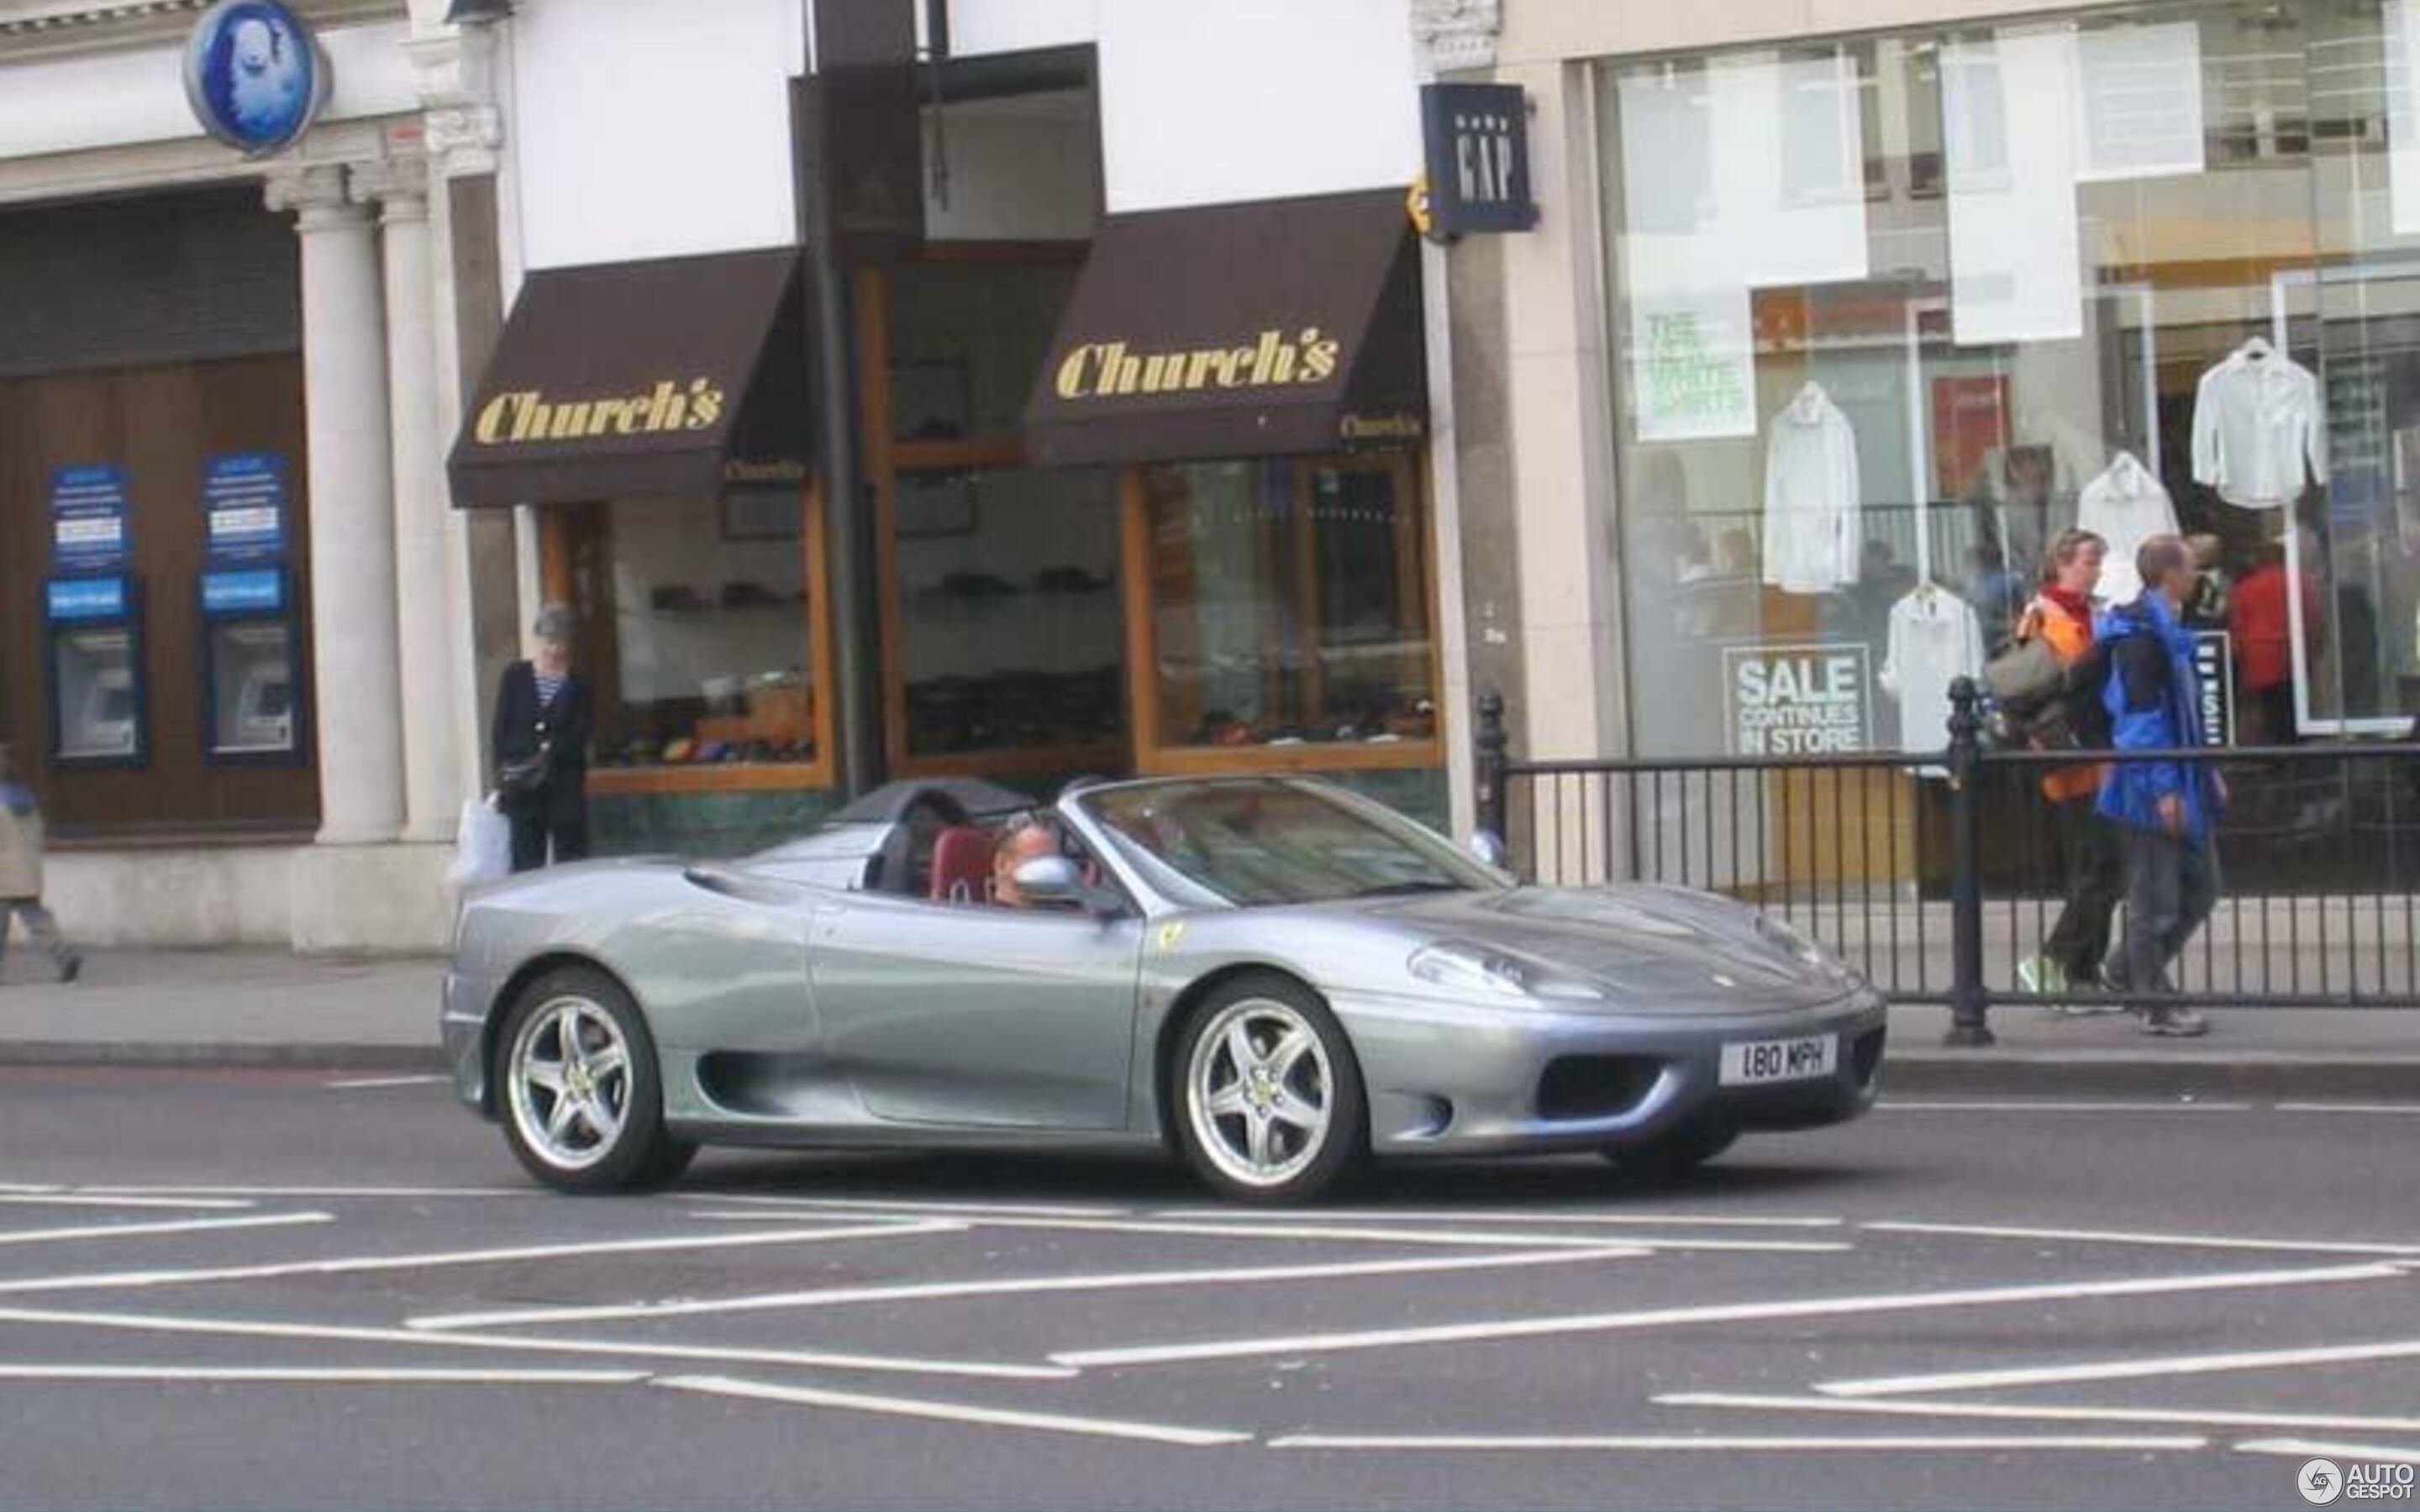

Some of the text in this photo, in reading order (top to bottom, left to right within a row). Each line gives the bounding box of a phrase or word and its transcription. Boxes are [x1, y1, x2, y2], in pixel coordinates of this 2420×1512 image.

[1458, 135, 1512, 202] GAP
[1056, 327, 1339, 399] Church's
[474, 376, 723, 444] Church's
[1739, 657, 1858, 705] SALE
[1739, 704, 1859, 727] CONTINUES
[1740, 726, 1860, 756] IN STORE
[1787, 1040, 1824, 1074] MPH
